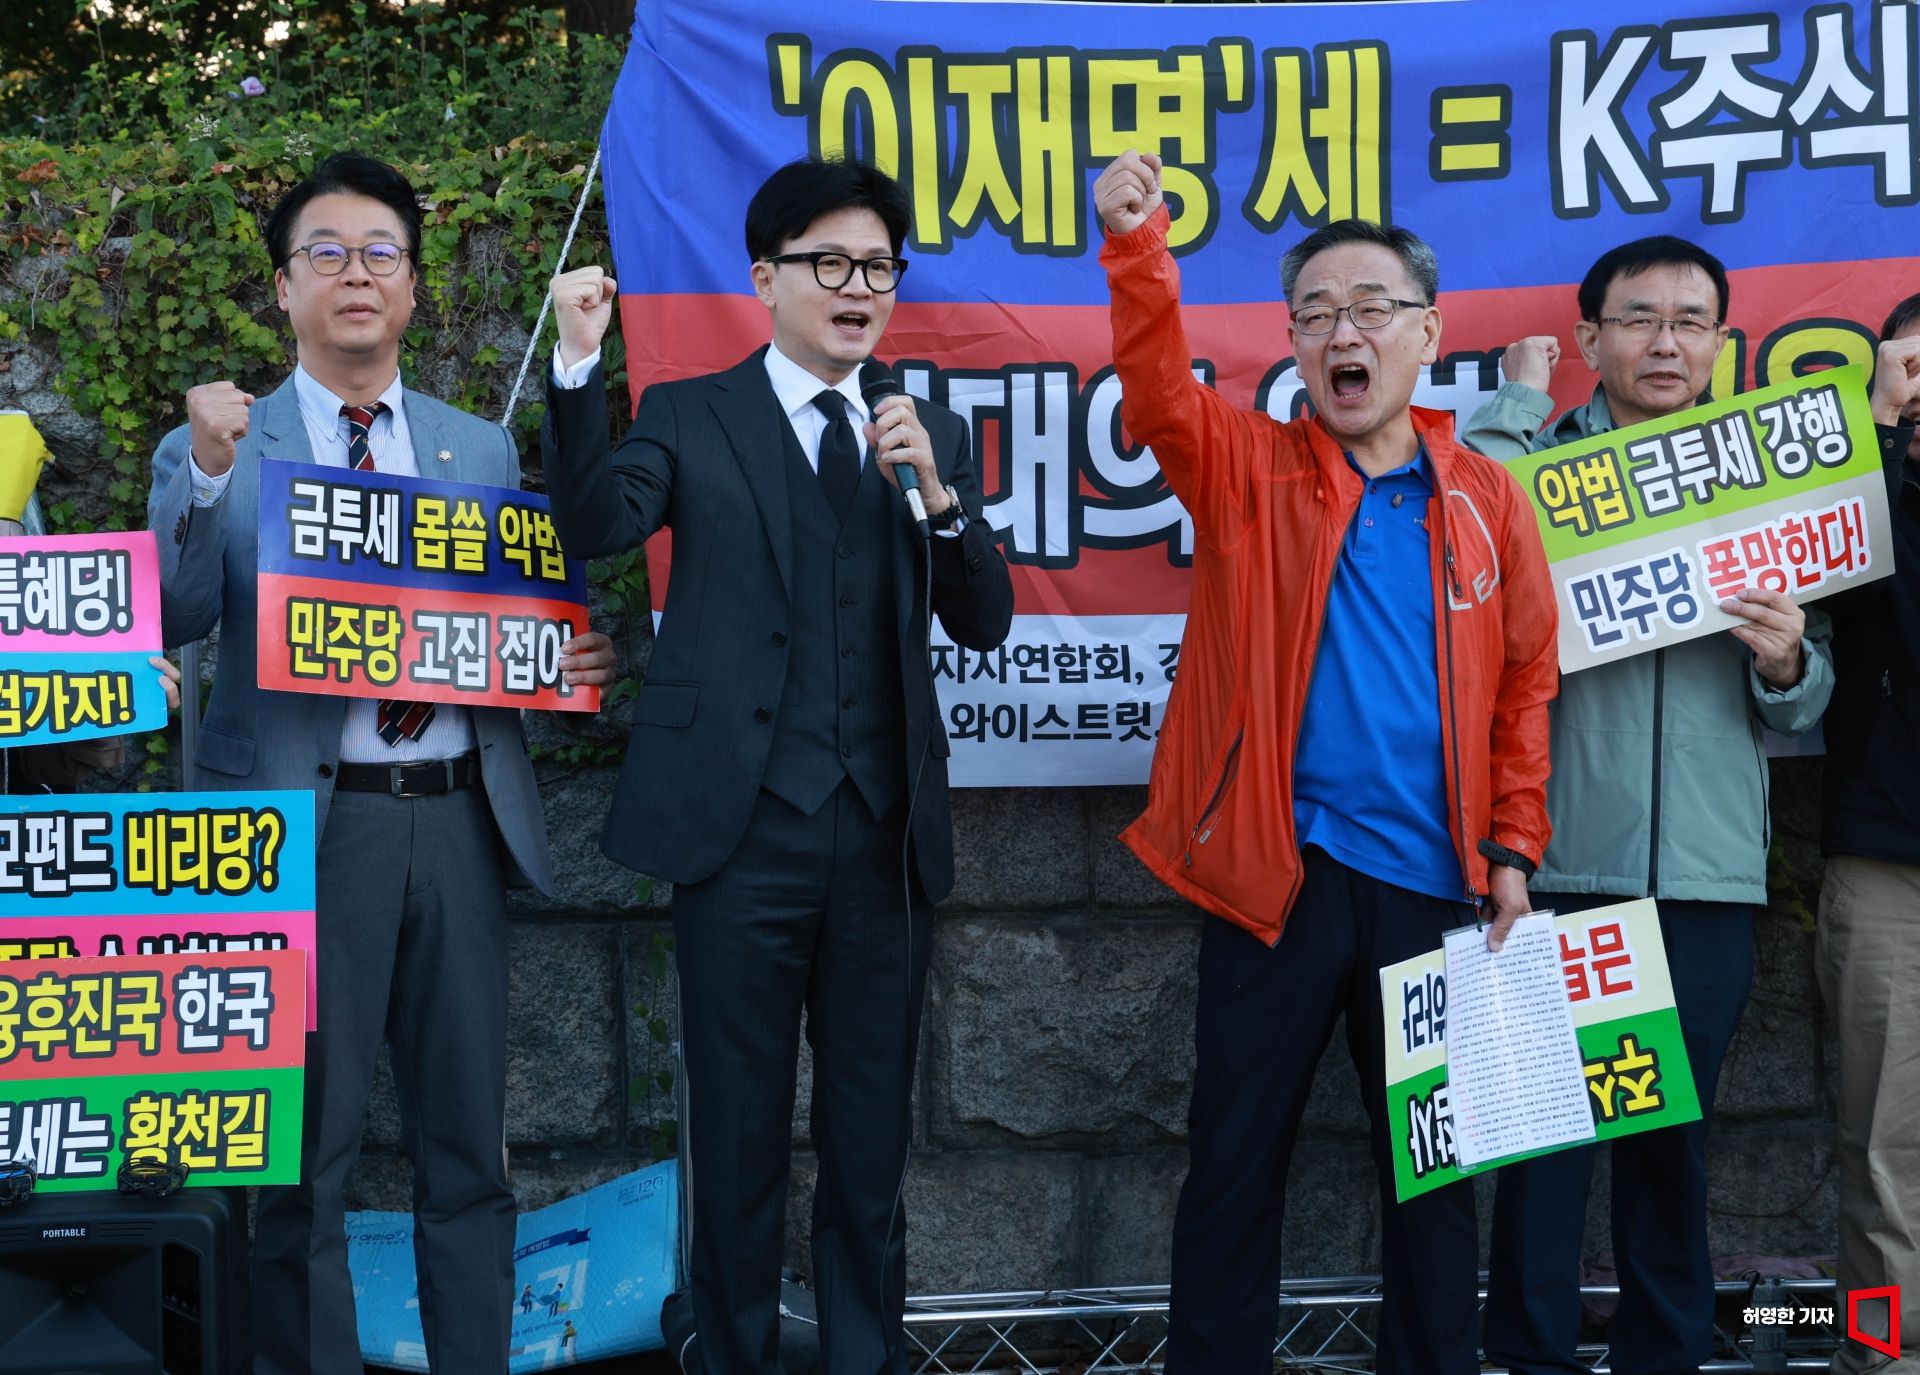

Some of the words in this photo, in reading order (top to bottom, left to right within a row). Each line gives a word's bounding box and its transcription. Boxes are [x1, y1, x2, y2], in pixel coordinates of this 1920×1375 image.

[1440, 95, 1501, 171] =
[1538, 453, 1629, 532] 악법
[1629, 415, 1761, 513] 금투세
[1758, 389, 1848, 475] 강행
[291, 482, 399, 565] 금투세
[413, 497, 486, 572] 몹쓸
[499, 506, 567, 581] 악법
[1570, 552, 1698, 647] 민주당
[290, 601, 401, 682] 민주당
[413, 614, 487, 688] 고집
[128, 812, 281, 891] 비리당?
[178, 970, 270, 1049] 한국
[0, 1103, 109, 1175] 세는
[125, 1093, 266, 1176] 황천길
[42, 1228, 86, 1239] PORTABLE
